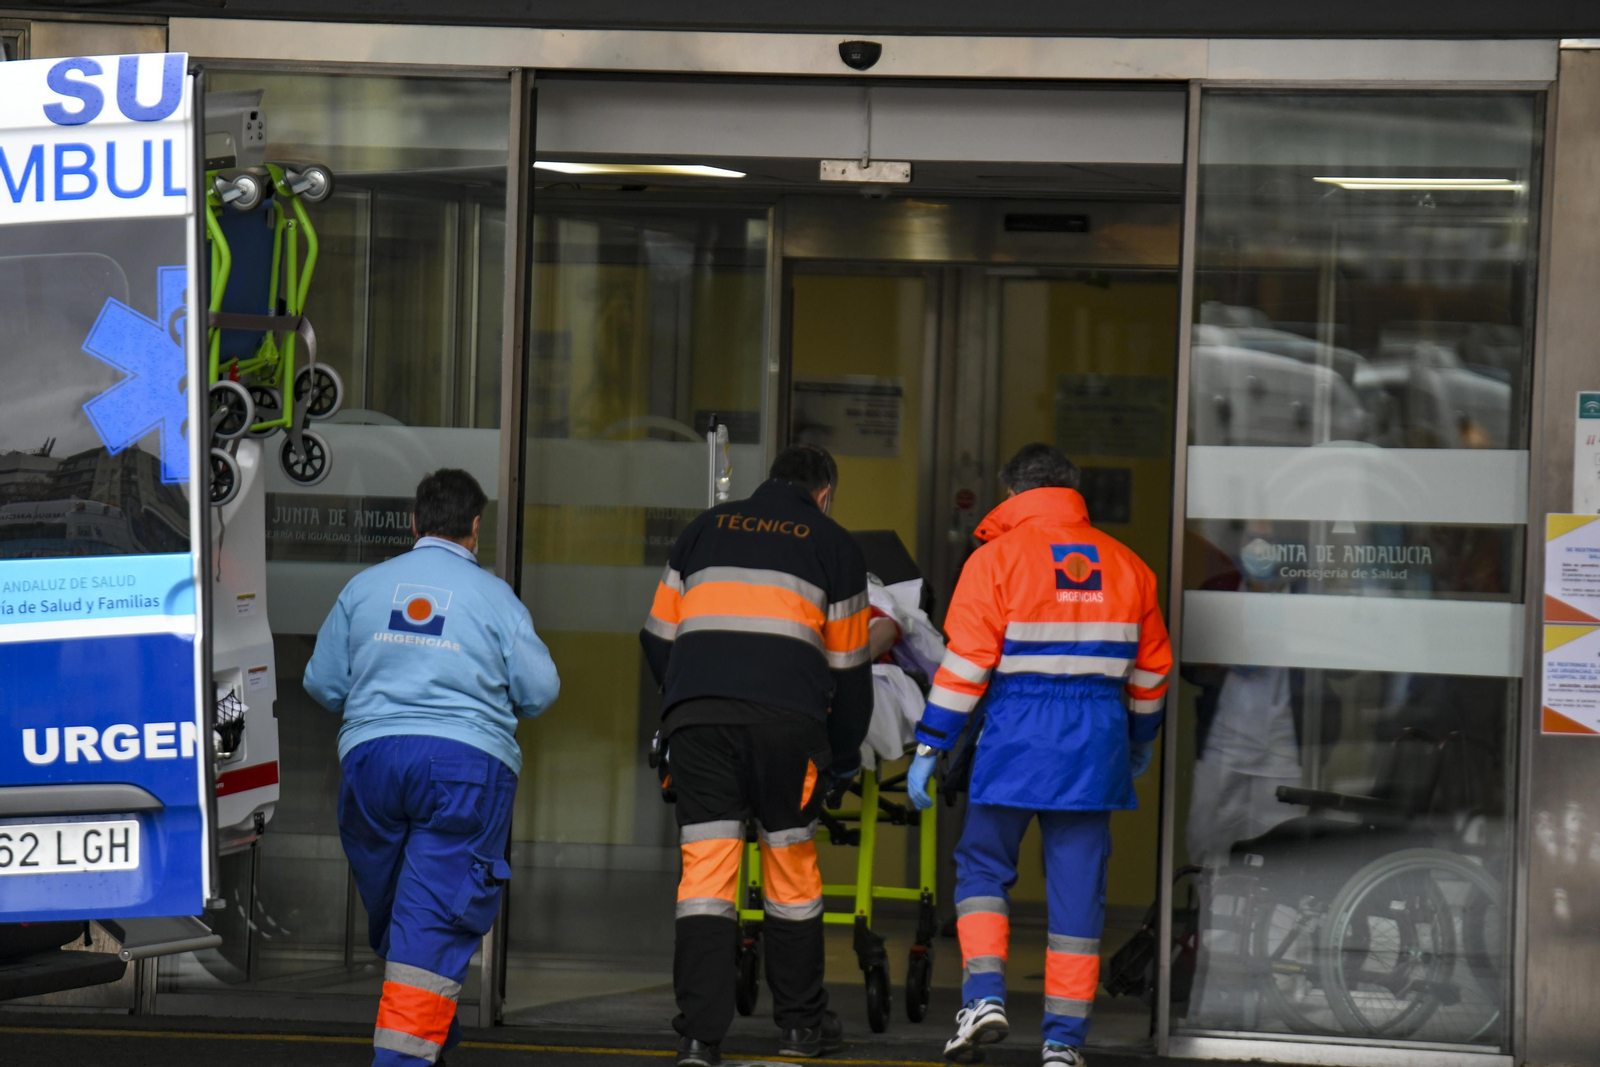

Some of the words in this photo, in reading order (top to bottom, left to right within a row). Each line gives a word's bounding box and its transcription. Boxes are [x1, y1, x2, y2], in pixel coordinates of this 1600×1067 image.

[42, 53, 186, 126] SU
[0, 138, 188, 204] MBUL
[272, 506, 320, 525] JUNTA
[329, 509, 346, 526] DE
[715, 512, 811, 538] TÉCNICO
[1315, 545, 1335, 563] DE
[2, 578, 66, 593] ANDALUZ
[70, 577, 87, 589] DE
[92, 574, 136, 588] SALUD
[1351, 568, 1368, 579] de
[1371, 568, 1408, 579] Salud
[0, 599, 14, 615] ía
[18, 600, 36, 614] de
[40, 598, 82, 613] Salud
[85, 600, 94, 613] y
[99, 594, 160, 610] Familias
[1056, 591, 1104, 603] URGENCIAS
[374, 632, 461, 652] URGENCIAS
[57, 827, 129, 865] LGH
